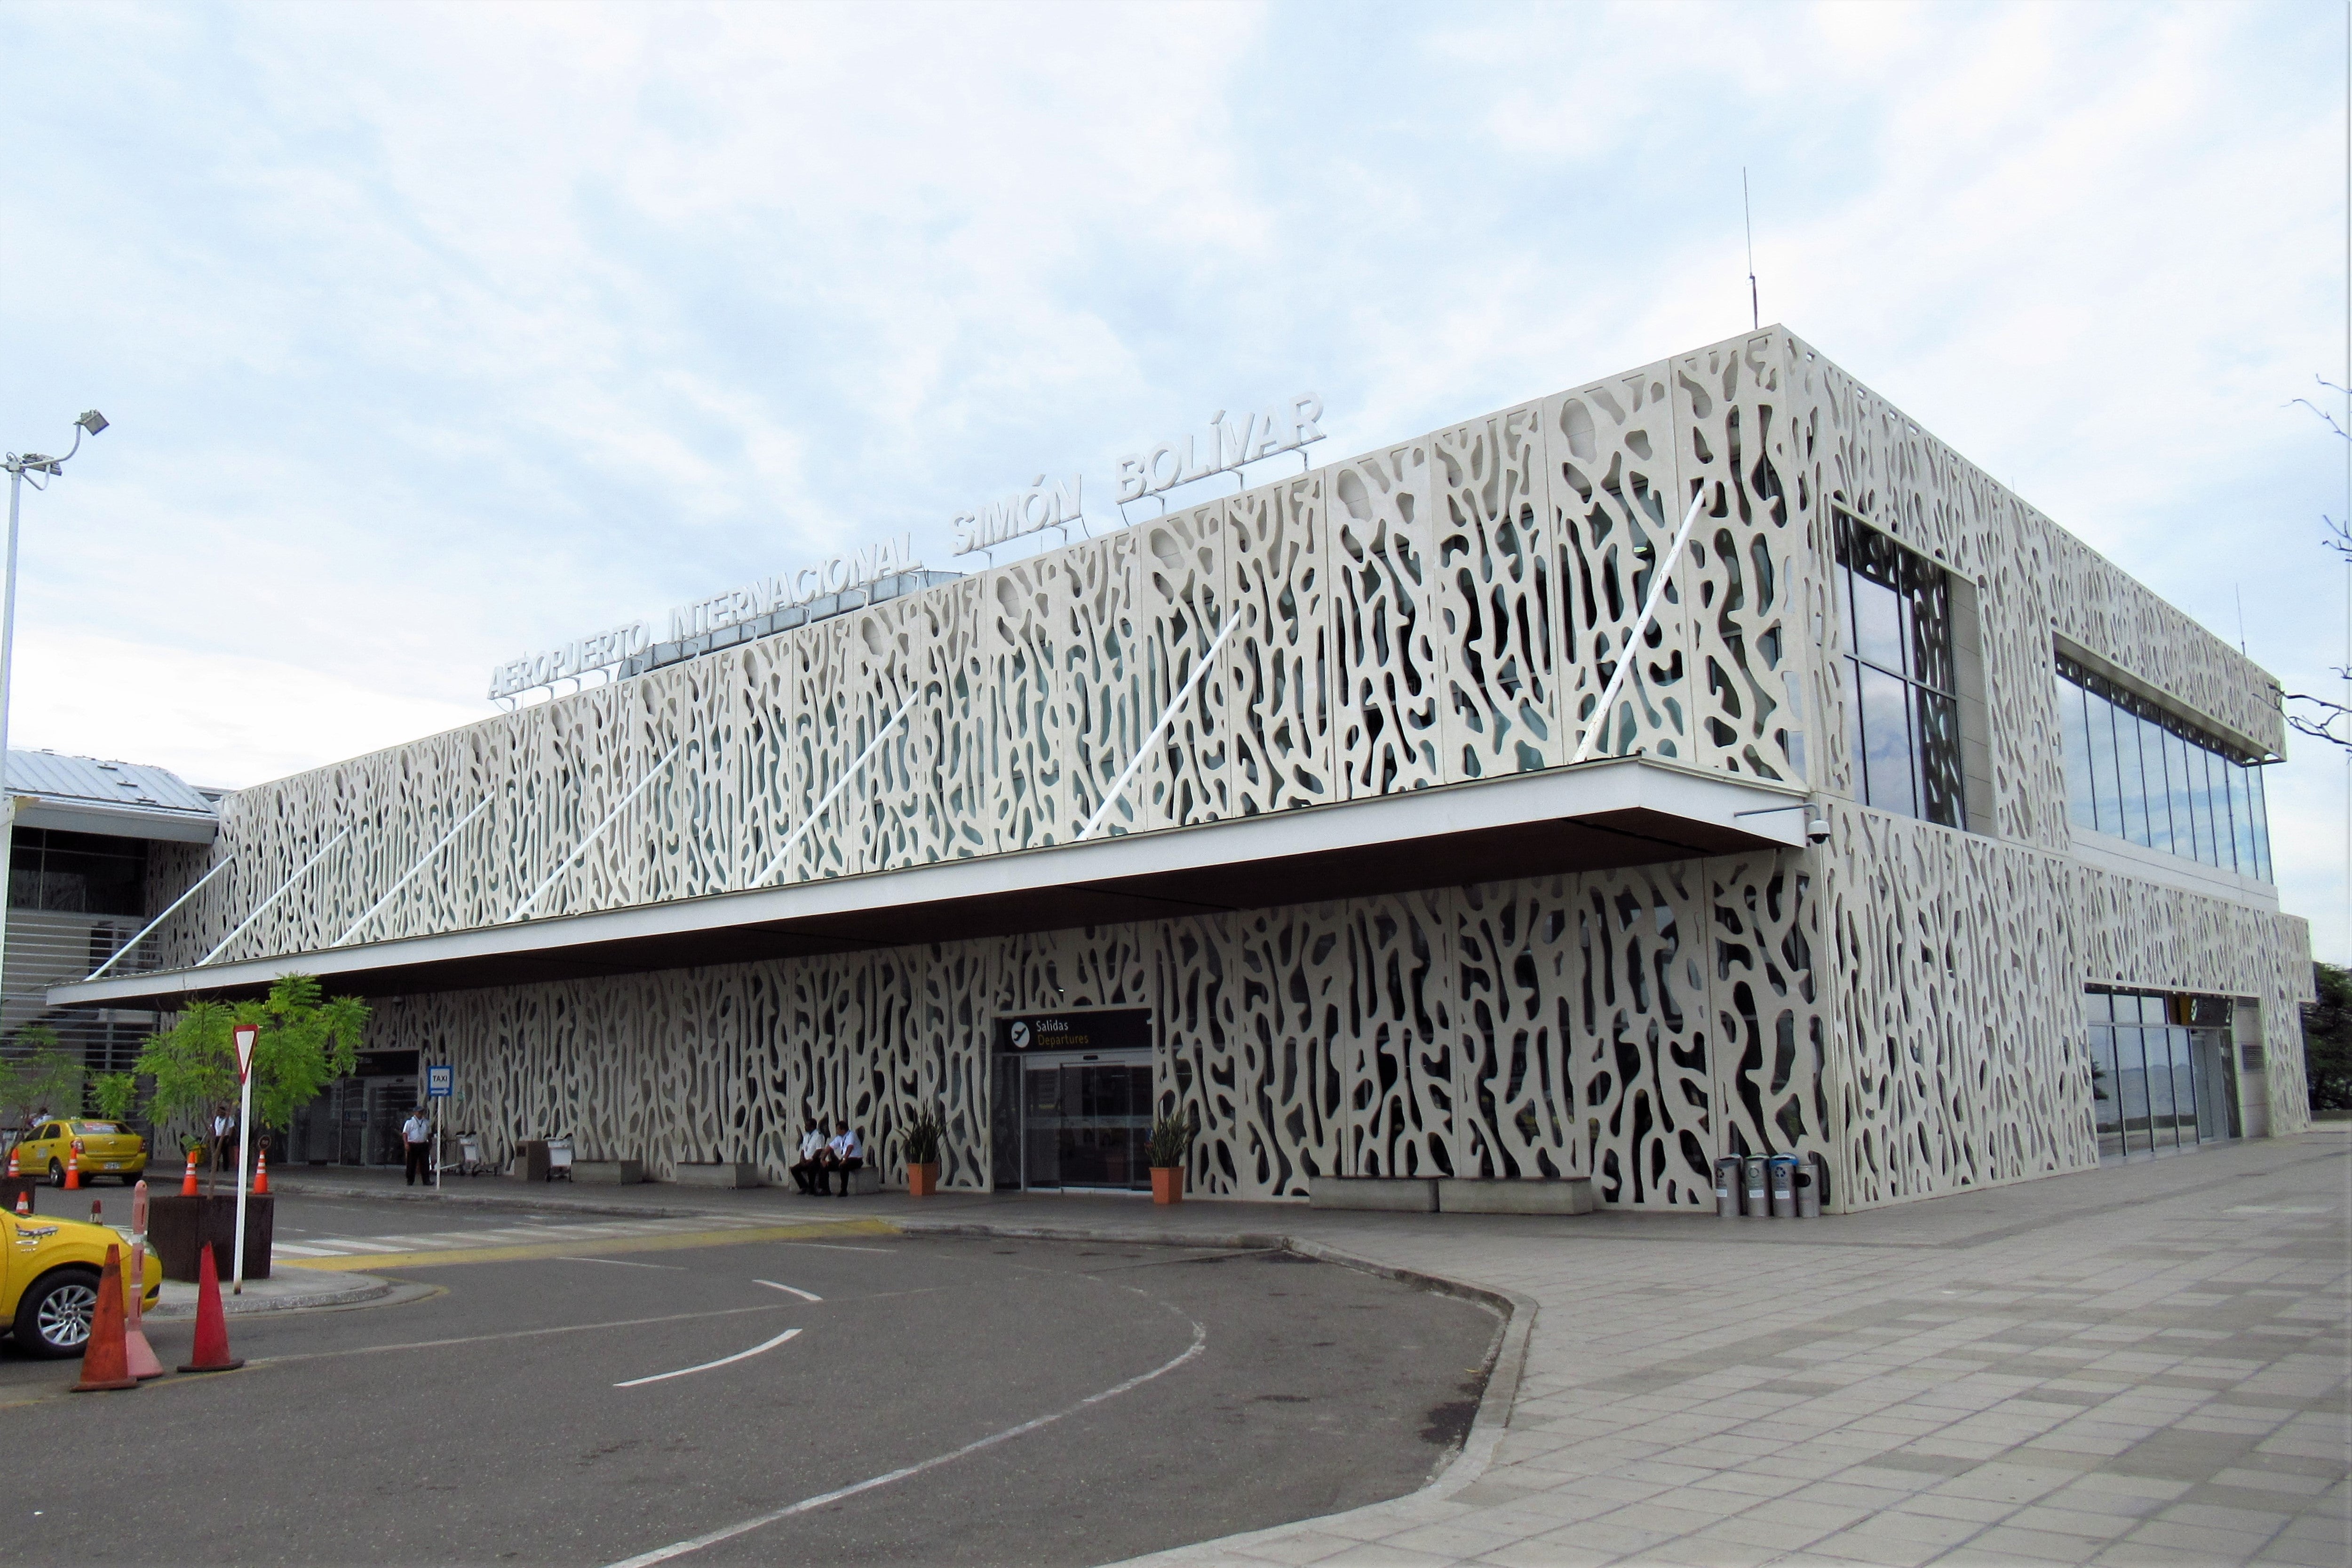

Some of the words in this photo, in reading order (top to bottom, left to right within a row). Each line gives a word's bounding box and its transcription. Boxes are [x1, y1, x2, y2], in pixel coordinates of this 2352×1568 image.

[487, 619, 650, 700] AEROPUERTO
[667, 532, 921, 644] INTERNACIONAL
[951, 474, 1081, 557] SIMÓN
[1116, 392, 1327, 504] BOLÍVAR
[1036, 1019, 1068, 1031] Salidas
[1038, 1034, 1089, 1048] Departures
